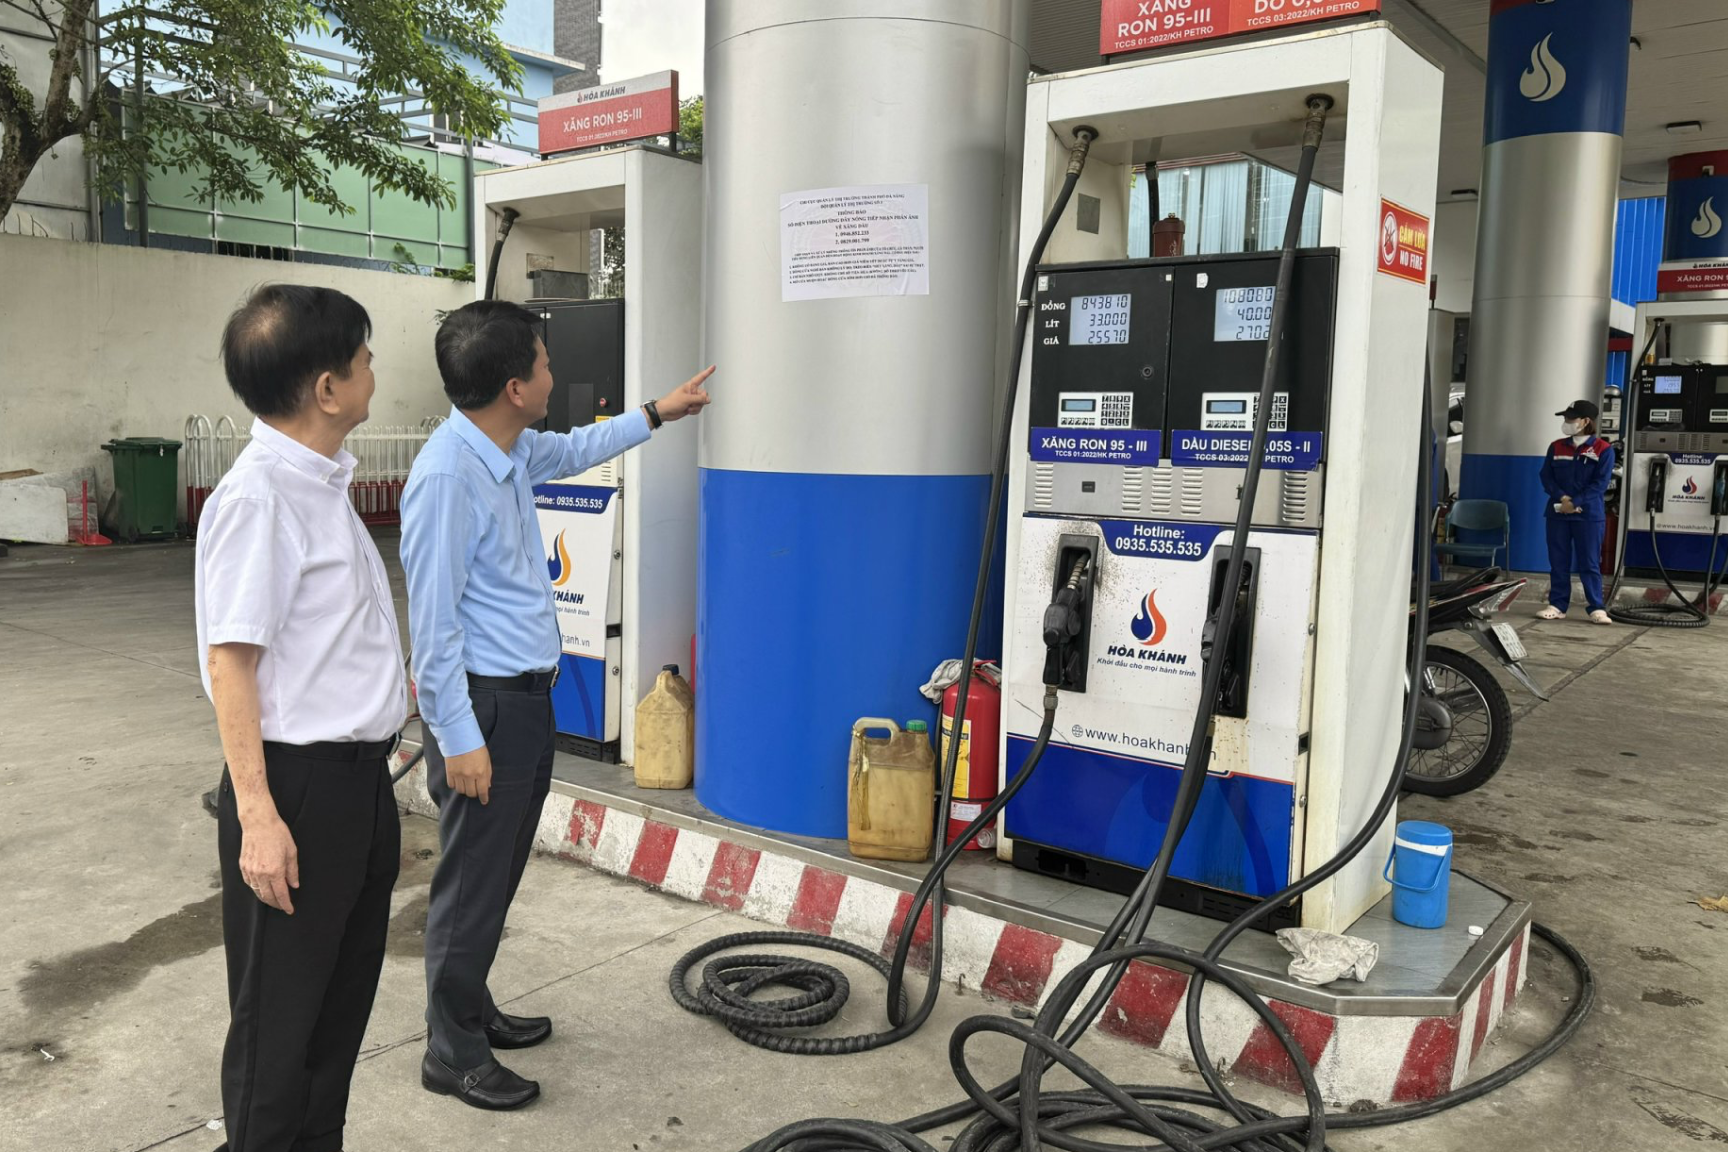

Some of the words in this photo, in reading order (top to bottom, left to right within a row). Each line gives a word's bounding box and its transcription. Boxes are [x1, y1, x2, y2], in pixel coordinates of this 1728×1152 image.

[1247, 16, 1271, 26] TCCS
[1326, 1, 1360, 13] PETRO
[1118, 17, 1157, 37] RON
[1163, 8, 1211, 29] 95-III
[1115, 40, 1136, 49] TCCS
[1184, 25, 1214, 38] PETRO
[563, 116, 591, 133] XĂNG
[592, 112, 614, 128] RON
[616, 107, 642, 123] 95-III
[1400, 250, 1409, 267] NO
[1410, 253, 1423, 271] FIRE
[1082, 295, 1129, 310] 843810
[1045, 318, 1060, 328] LÍT
[1043, 335, 1060, 345] GIÁ
[1088, 329, 1128, 344] 25570
[1041, 436, 1077, 450] XĂNG
[1079, 438, 1107, 451] RON
[1110, 440, 1125, 452] 95
[1136, 440, 1148, 452] III
[1181, 436, 1208, 451] DẦU
[1303, 441, 1311, 453] II
[1055, 450, 1073, 458] TCCS
[1108, 452, 1133, 461] PETRO
[1195, 452, 1218, 461] TCCS
[1265, 455, 1295, 464] PETRO
[556, 495, 604, 510] 0935.535.535
[1133, 524, 1185, 539] Hotline:
[1115, 536, 1202, 557] 0935.535.535
[1107, 644, 1135, 659] HÒA
[1138, 649, 1188, 666] KHÁNH
[1129, 661, 1143, 670] cho
[1143, 664, 1159, 673] mọi
[1158, 666, 1178, 675] hành
[1178, 668, 1197, 678] trình
